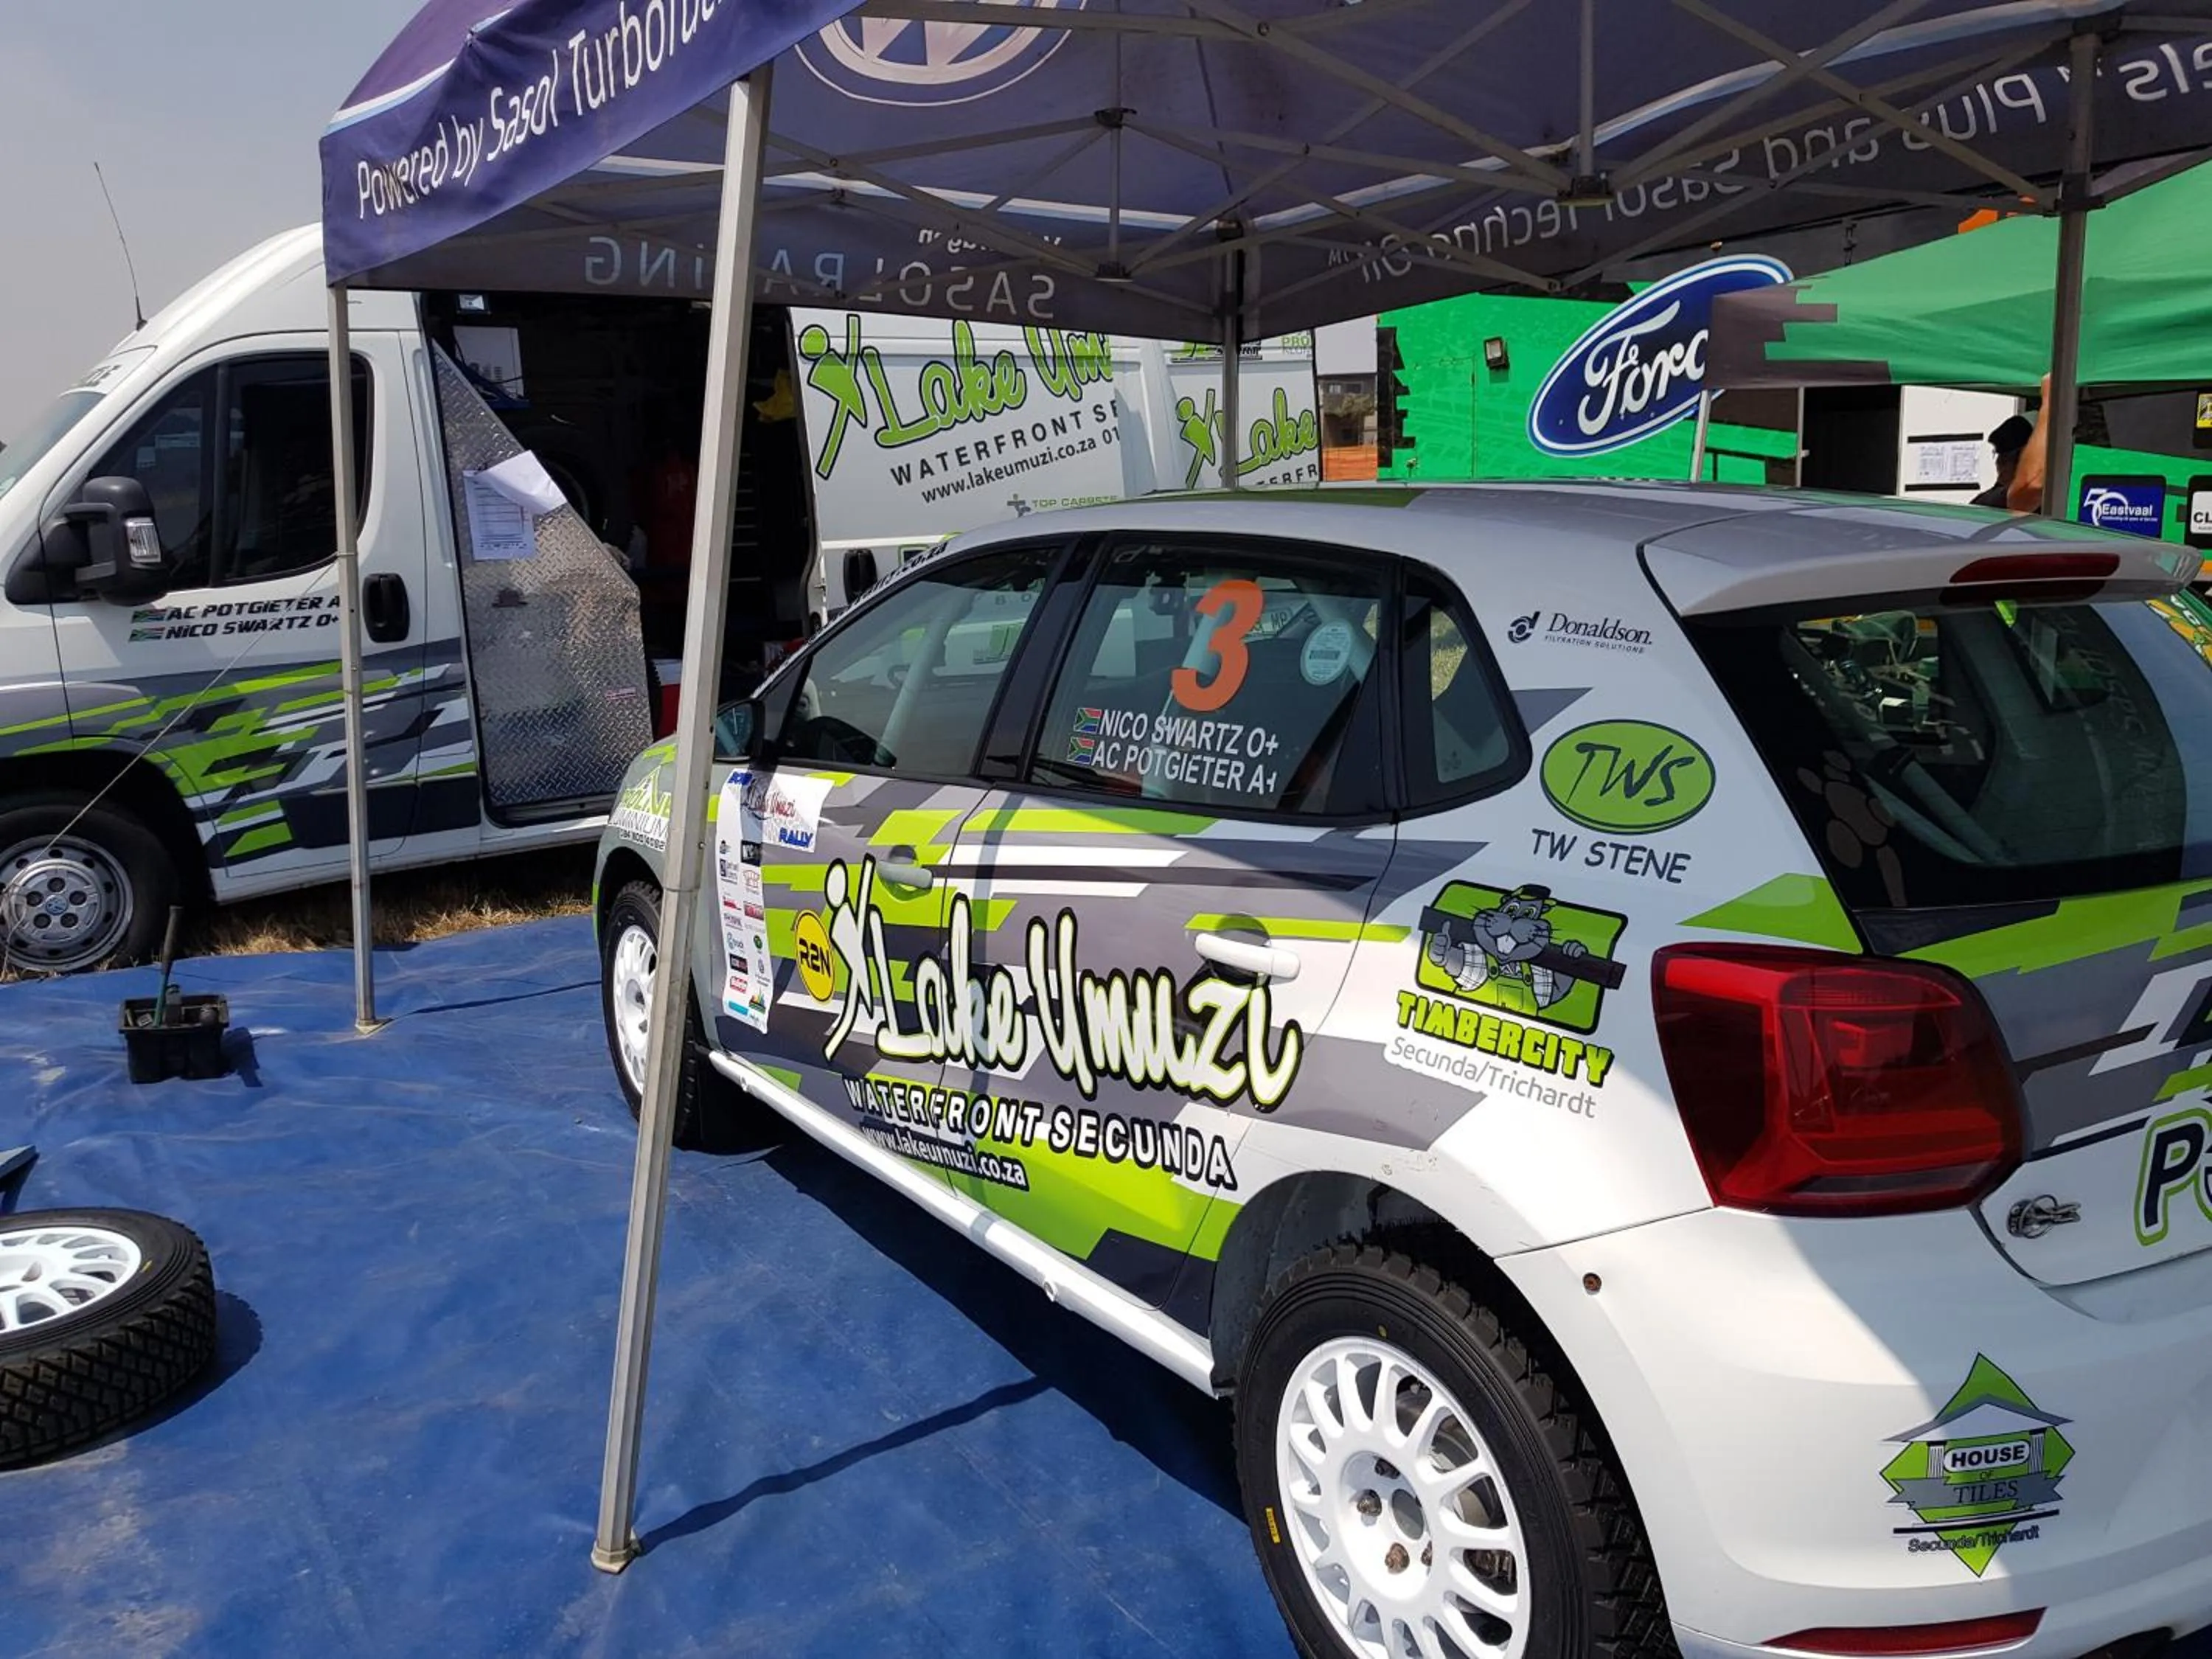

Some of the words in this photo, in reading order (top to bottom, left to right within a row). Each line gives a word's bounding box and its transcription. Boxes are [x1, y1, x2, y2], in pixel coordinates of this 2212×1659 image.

[357, 122, 448, 220] Powered
[451, 115, 484, 187] by
[487, 49, 559, 161] Sasol
[568, 0, 722, 116] Turbou
[860, 319, 1027, 448] Lake
[890, 411, 1082, 487] WATERFRONT
[922, 437, 1096, 503] www.lakeumuzi.co.za
[1033, 499, 1057, 508] TOP
[2101, 503, 2152, 516] Eastvaal
[165, 623, 218, 640] NICO
[222, 616, 310, 635] SWARTZ
[167, 605, 197, 621] AC
[202, 596, 323, 619] POTGIETER
[1171, 579, 1263, 712] 3
[1594, 641, 1644, 653] SOLUTIONS
[1098, 709, 1147, 740] NICO
[1152, 714, 1244, 755] SWARTZ
[1091, 740, 1119, 770] AC
[1124, 747, 1245, 790] POTGIETER
[1576, 742, 1695, 807] TWS
[1531, 828, 1577, 861] TW
[1585, 841, 1691, 883] STENE
[867, 891, 1026, 1071] Lake
[1026, 907, 1302, 1113] Umuzi
[1397, 990, 1614, 1086] TIMBERCITY
[1391, 1036, 1596, 1119] Secunda/Trichardt
[844, 1077, 1043, 1145] WATERFRONT
[1048, 1109, 1237, 1189] SECUNDA
[861, 1125, 1027, 1188] www.lakeumuzi.co.za
[1951, 1444, 2025, 1467] HOUSE
[1954, 1480, 2018, 1503] TILES
